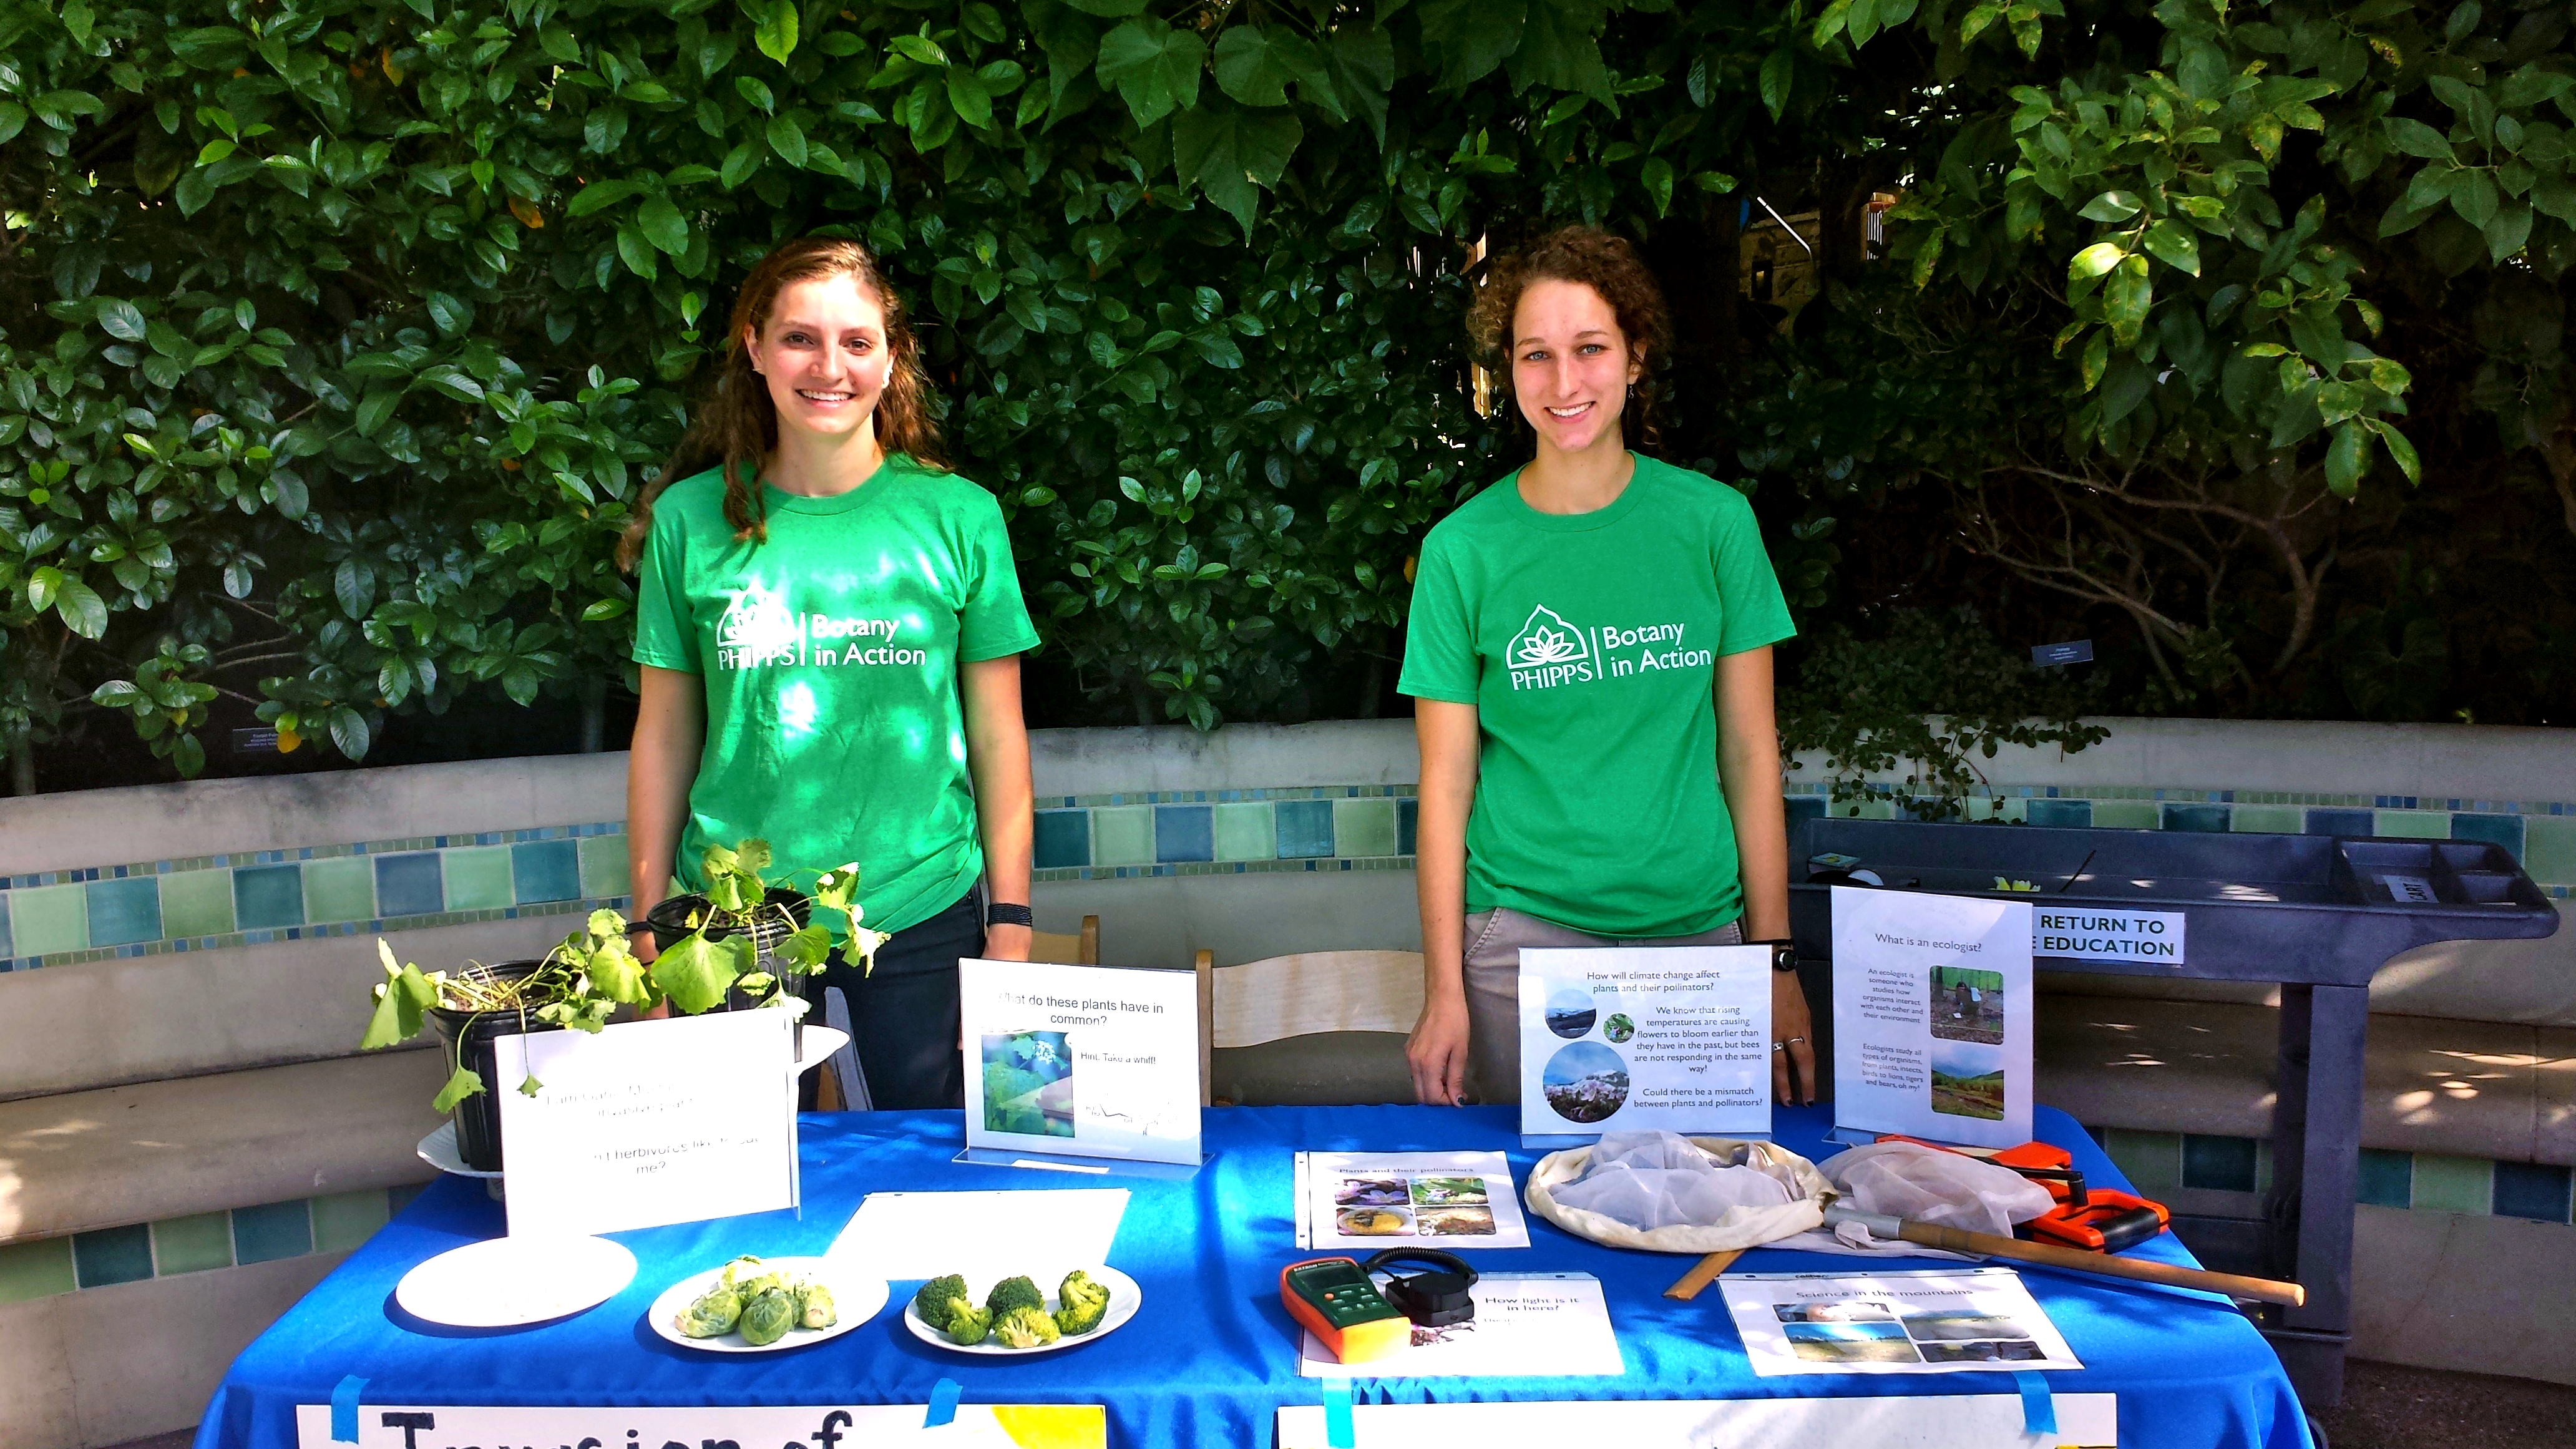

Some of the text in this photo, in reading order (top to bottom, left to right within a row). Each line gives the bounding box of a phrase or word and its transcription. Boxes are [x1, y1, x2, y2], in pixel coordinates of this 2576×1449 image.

[811, 614, 900, 642] Botany
[1602, 623, 1685, 650] Botany
[718, 645, 796, 670] PHIPPS
[814, 642, 927, 666] in Action
[1610, 647, 1712, 678] in Action
[1510, 661, 1593, 691] PHIPPS
[2403, 882, 2427, 900] CART
[2041, 915, 2165, 934] RETURN TO
[1875, 933, 1904, 945] What
[1907, 937, 1914, 945] is
[1933, 940, 1982, 954] ecologist?
[2044, 936, 2174, 956] EDUCATION
[1587, 972, 1609, 980] How
[1663, 971, 1693, 980] change
[1696, 970, 1720, 978] affect
[1879, 970, 1907, 978] ecologist
[1593, 982, 1714, 994] plants and their pollinators?
[1029, 995, 1043, 1006] do
[1046, 996, 1078, 1008] these
[1082, 998, 1117, 1012] plants
[1121, 1000, 1149, 1013] have
[1153, 1003, 1163, 1014] in
[1896, 997, 1921, 1005] interact
[1718, 1006, 1740, 1015] rising
[1050, 1015, 1107, 1027] common?
[1646, 1019, 1702, 1028] temperatures
[1720, 1018, 1750, 1027] causing
[1637, 1042, 1654, 1051] they
[1704, 1042, 1723, 1050] past,
[1863, 1043, 1894, 1053] Ecologists
[1133, 1056, 1156, 1065] whiff!
[1667, 1053, 1712, 1062] responding
[1889, 1056, 1922, 1065] organisms,
[1689, 1065, 1707, 1074] way!
[1879, 1063, 1899, 1071] plants,
[1634, 1100, 1669, 1108] between
[1672, 1100, 1695, 1109] plants
[1715, 1098, 1762, 1108] pollinators?
[615, 1143, 688, 1159] herbivores
[637, 1161, 666, 1174] me?
